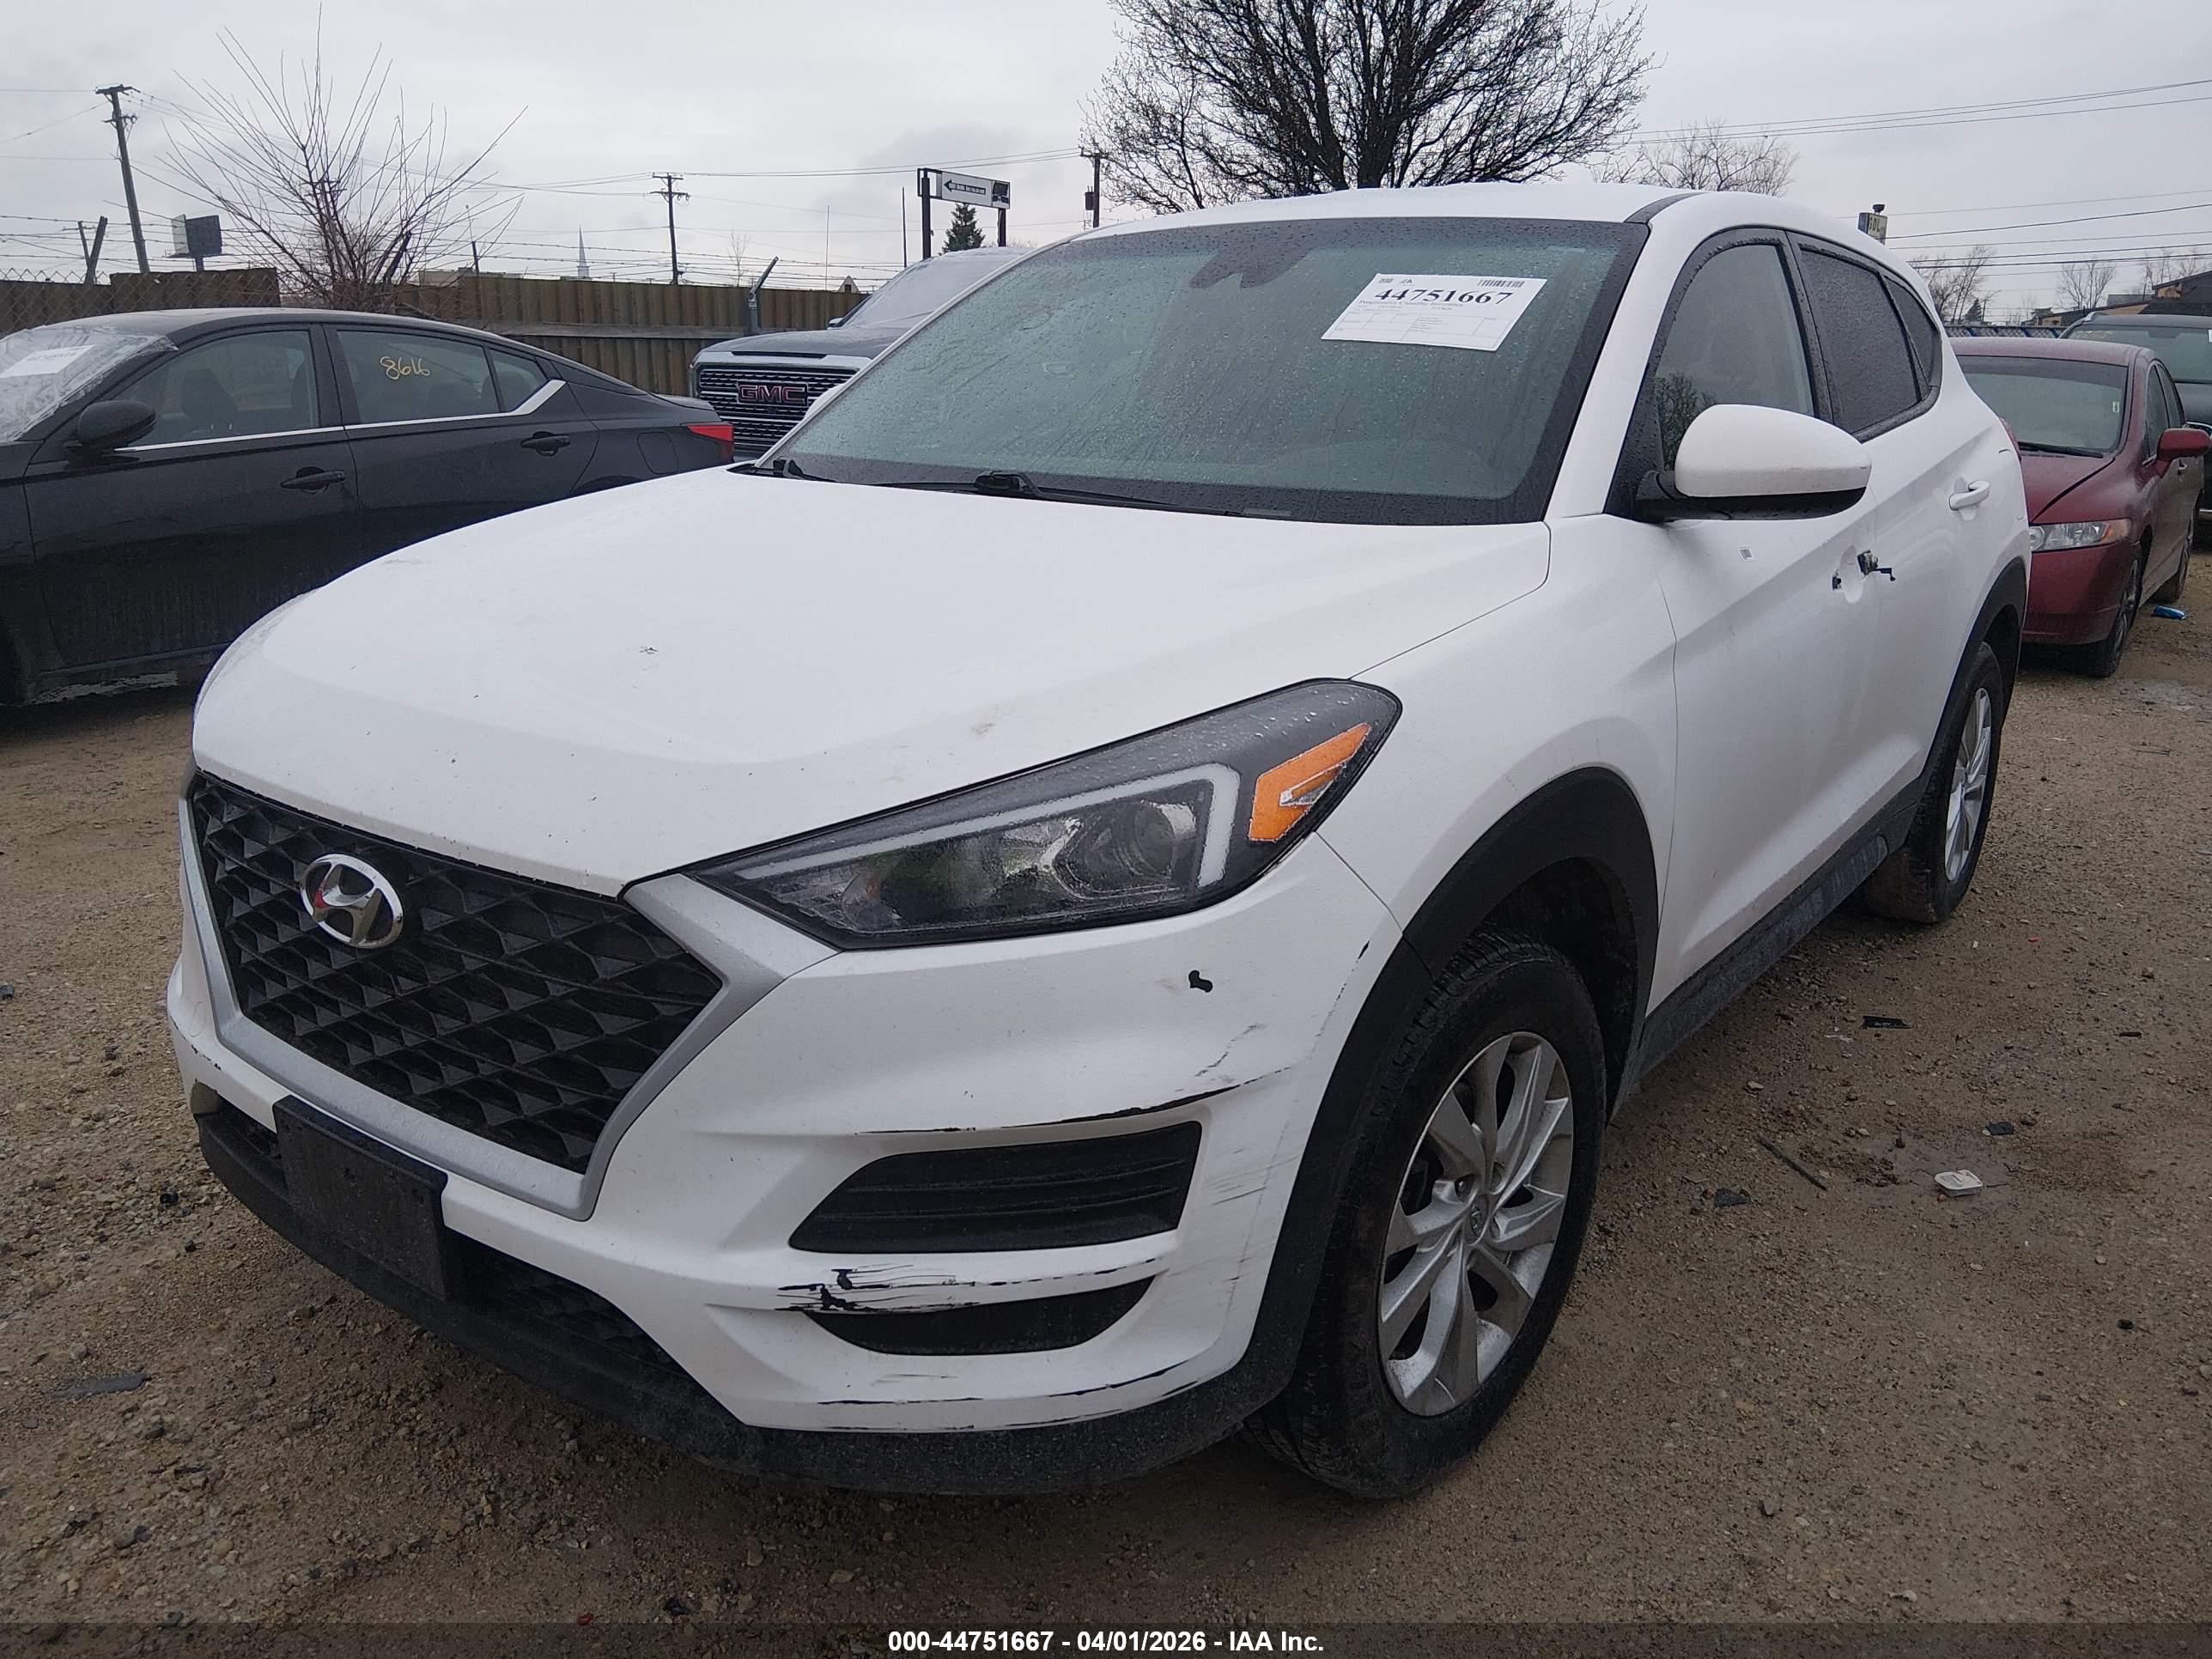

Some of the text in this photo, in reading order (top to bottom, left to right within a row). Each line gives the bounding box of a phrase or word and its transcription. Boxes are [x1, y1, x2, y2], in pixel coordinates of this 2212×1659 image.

[1374, 288, 1514, 305] 44751667
[380, 356, 431, 380] 8616
[738, 384, 807, 404] GMC
